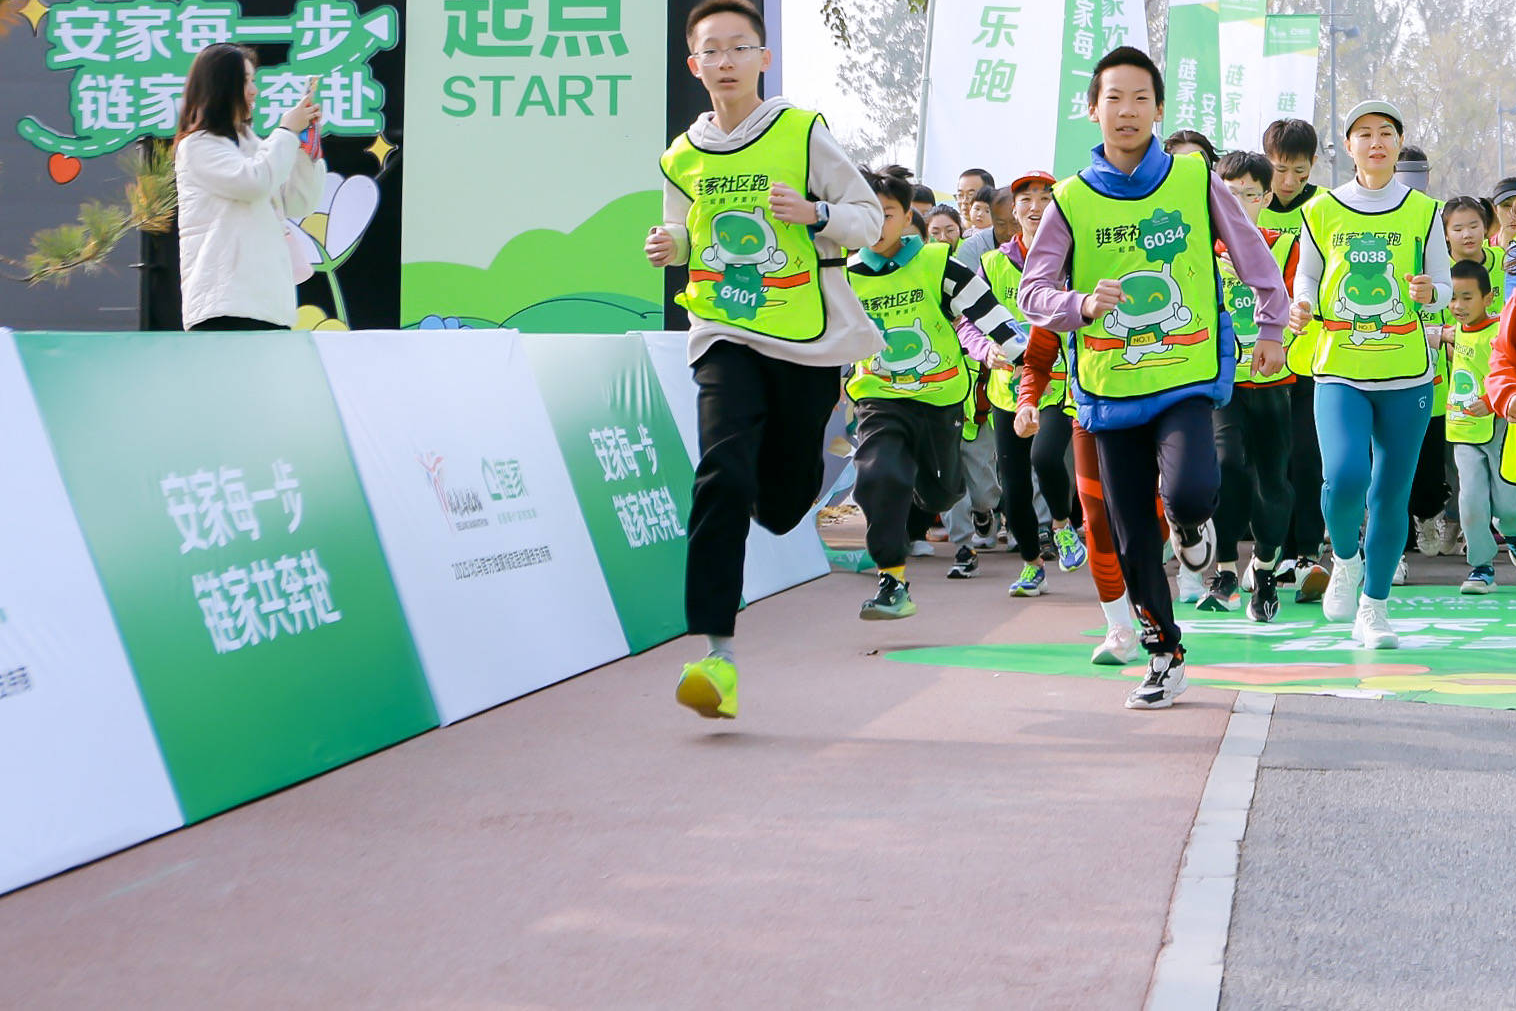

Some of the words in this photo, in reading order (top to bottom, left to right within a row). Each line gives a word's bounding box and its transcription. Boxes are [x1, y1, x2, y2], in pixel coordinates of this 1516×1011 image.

[53, 4, 352, 62] 安家每一步
[78, 71, 375, 130] 链家奔赴
[441, 74, 632, 119] START
[1176, 58, 1198, 132] 链家共
[1143, 226, 1185, 249] 6034
[1350, 250, 1387, 263] 6038
[720, 285, 757, 307] 6101
[589, 424, 657, 482] 安家每一步
[160, 458, 303, 555] 安家每一步
[612, 486, 687, 549] 链家共奔赴
[192, 548, 342, 654] 链家共奔赴
